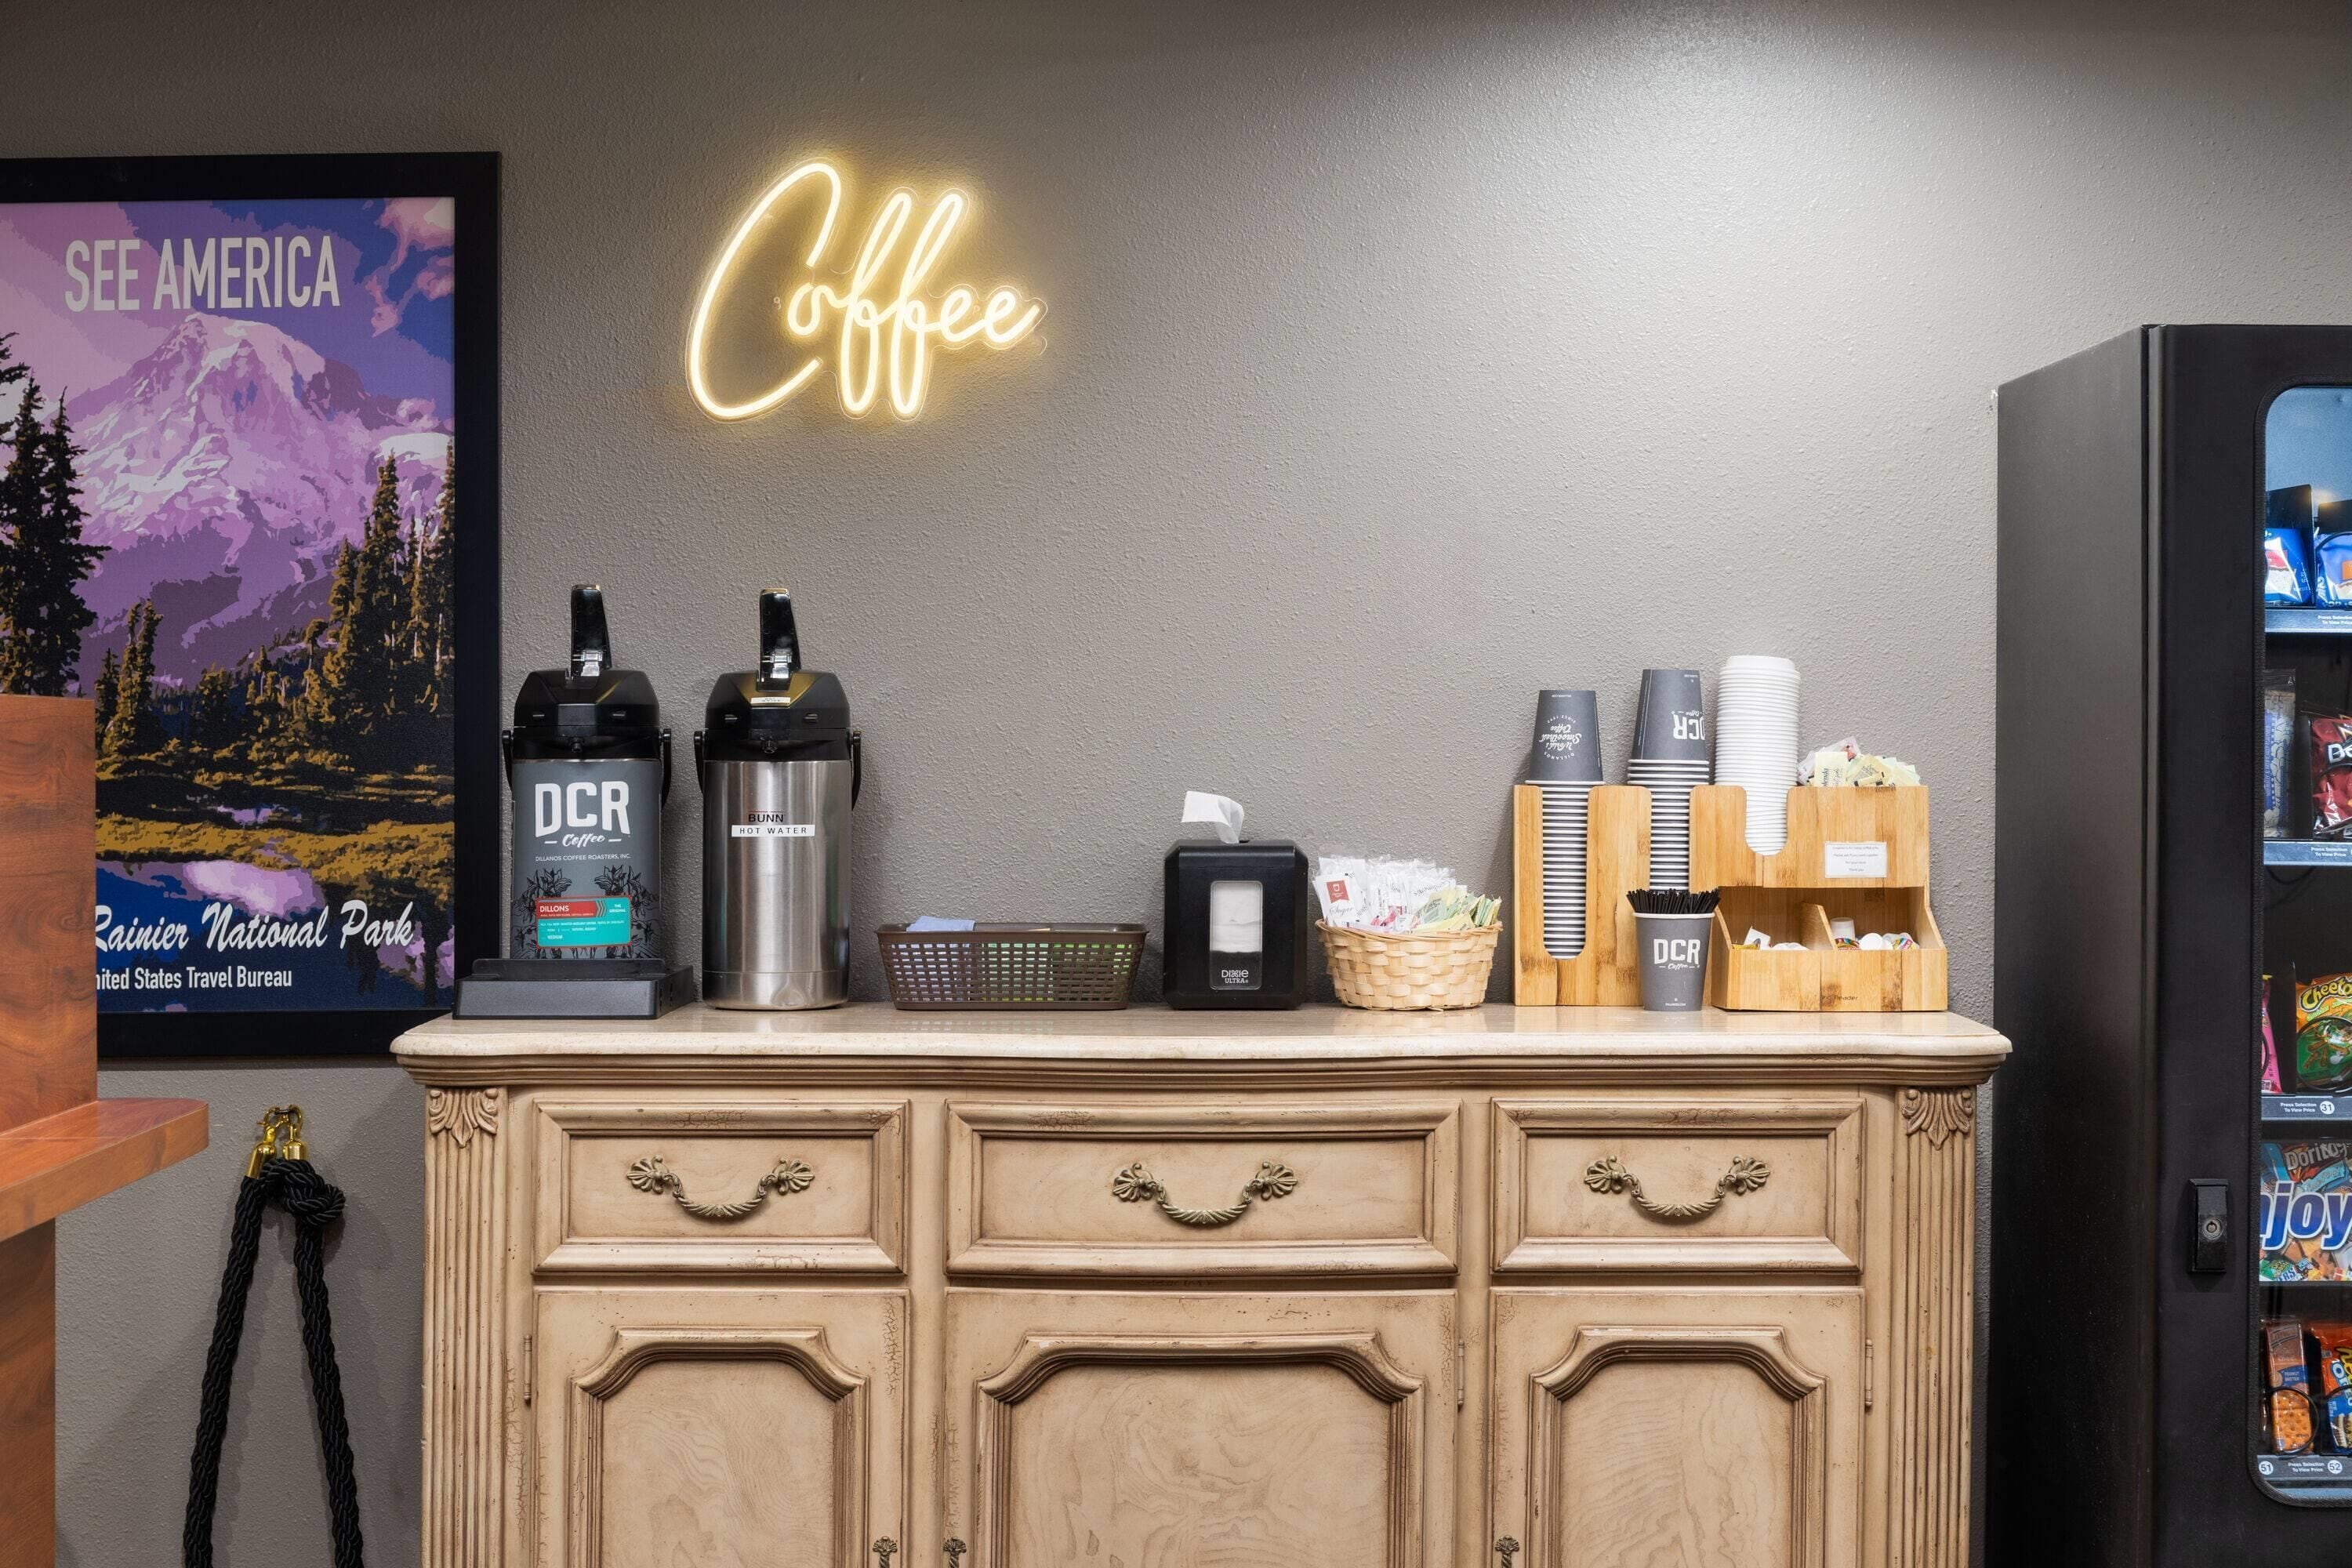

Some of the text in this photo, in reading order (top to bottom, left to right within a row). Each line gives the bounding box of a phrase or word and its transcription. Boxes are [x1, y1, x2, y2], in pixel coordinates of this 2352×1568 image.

[64, 235, 341, 312] SEE AMERICA
[689, 162, 1041, 418] Coffee
[1550, 724, 1571, 734] Coffee
[535, 781, 630, 838] DCR
[748, 814, 784, 822] BUNN
[562, 833, 605, 848] Coffee
[95, 899, 414, 953] Rainier National Park
[1653, 938, 1700, 964] DCR
[134, 967, 182, 989] States
[186, 965, 233, 988] Travel
[237, 965, 292, 988] Bureau
[2260, 1464, 2271, 1472] 51
[2329, 1462, 2341, 1471] 52
